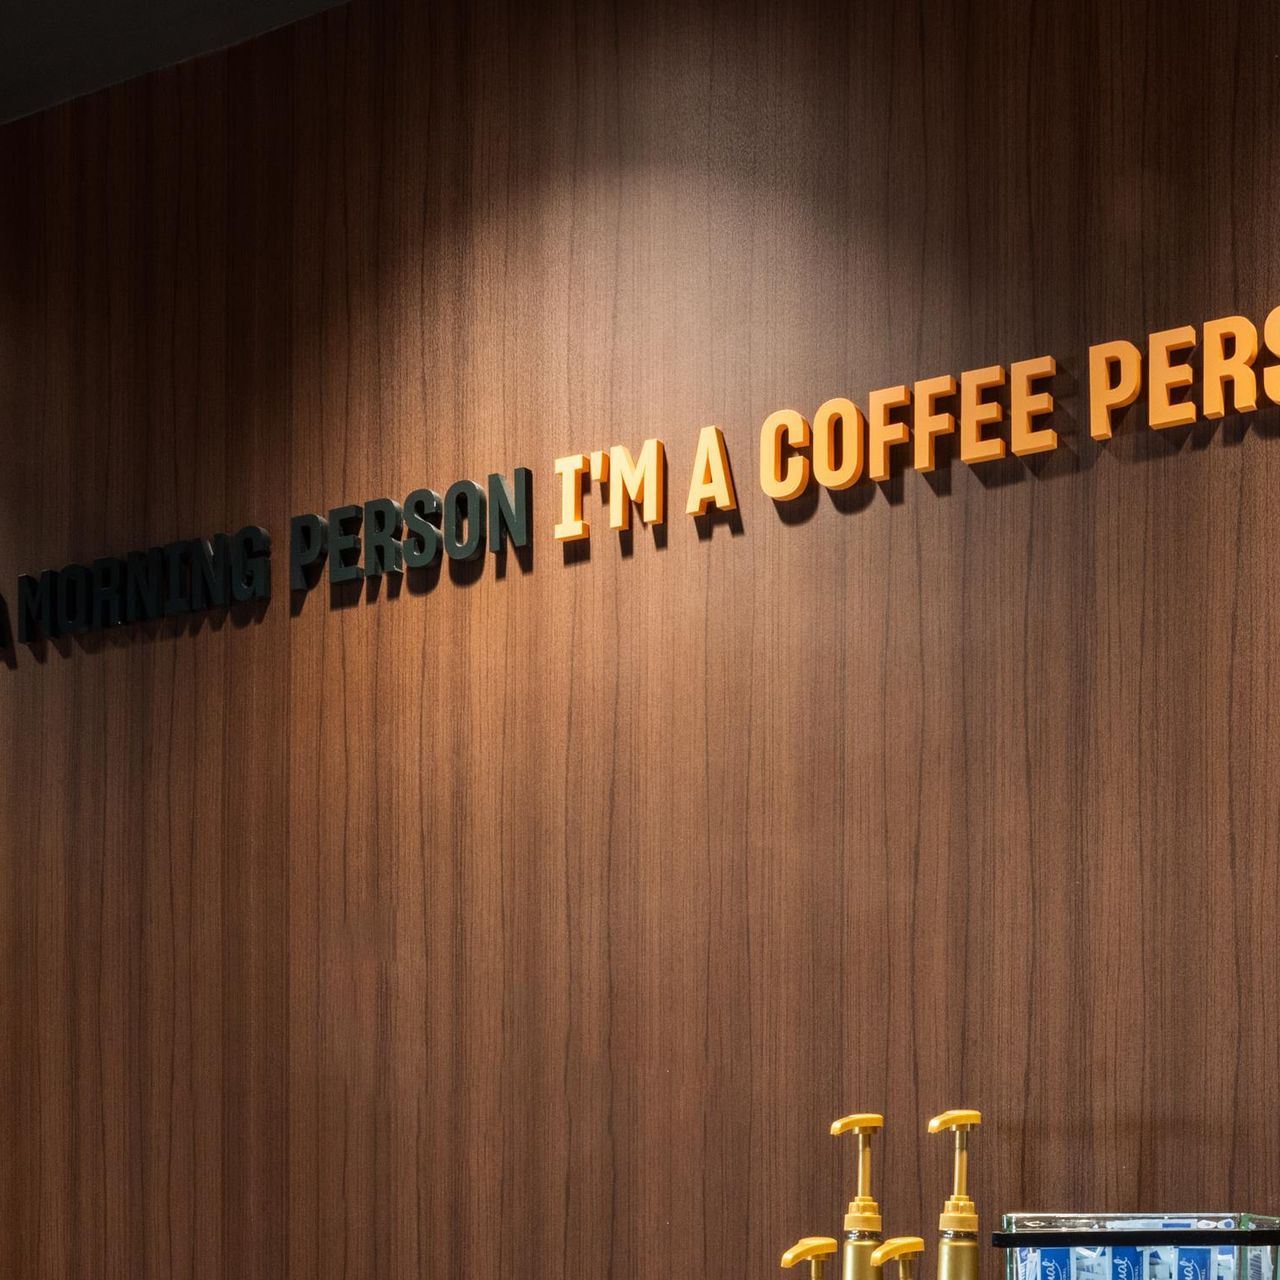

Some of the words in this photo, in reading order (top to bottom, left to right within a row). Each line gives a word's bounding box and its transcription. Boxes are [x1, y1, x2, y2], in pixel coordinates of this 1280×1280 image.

[18, 526, 271, 643] MORNING
[291, 467, 532, 592] PERSON
[554, 438, 664, 541] I'M
[686, 425, 737, 517] A
[760, 356, 1058, 502] COFFEE
